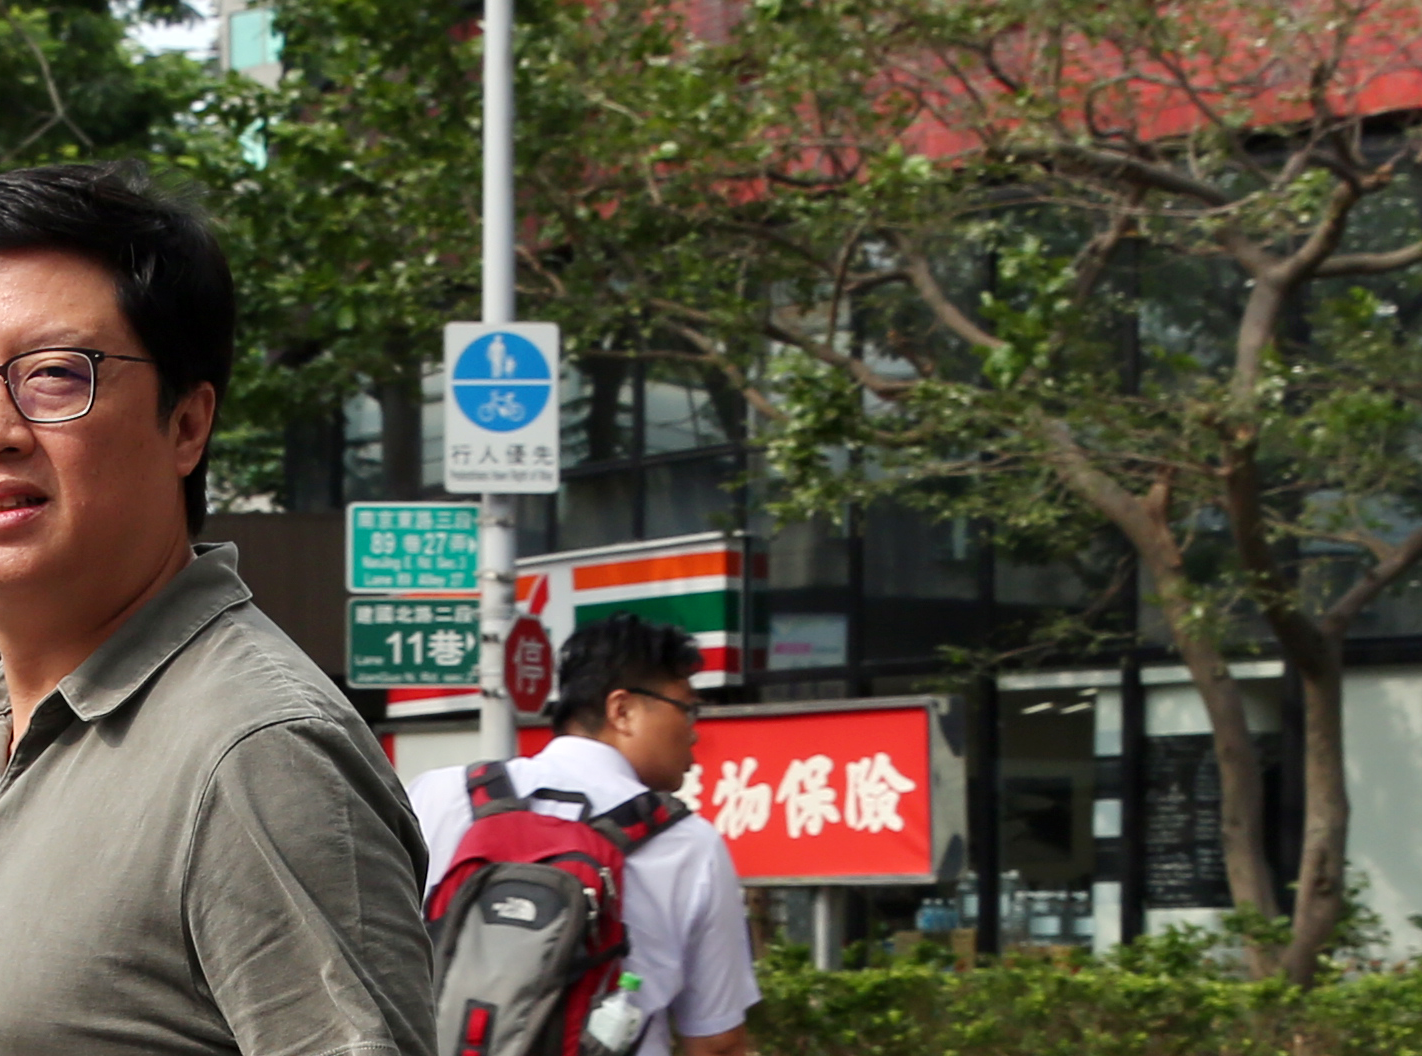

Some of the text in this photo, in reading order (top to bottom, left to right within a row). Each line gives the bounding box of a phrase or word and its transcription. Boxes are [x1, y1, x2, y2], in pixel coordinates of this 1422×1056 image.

[451, 444, 555, 466] 行人優先
[358, 511, 472, 529] 南京東路三段
[355, 605, 472, 623] 建國北路二段
[385, 630, 465, 666] 11巷
